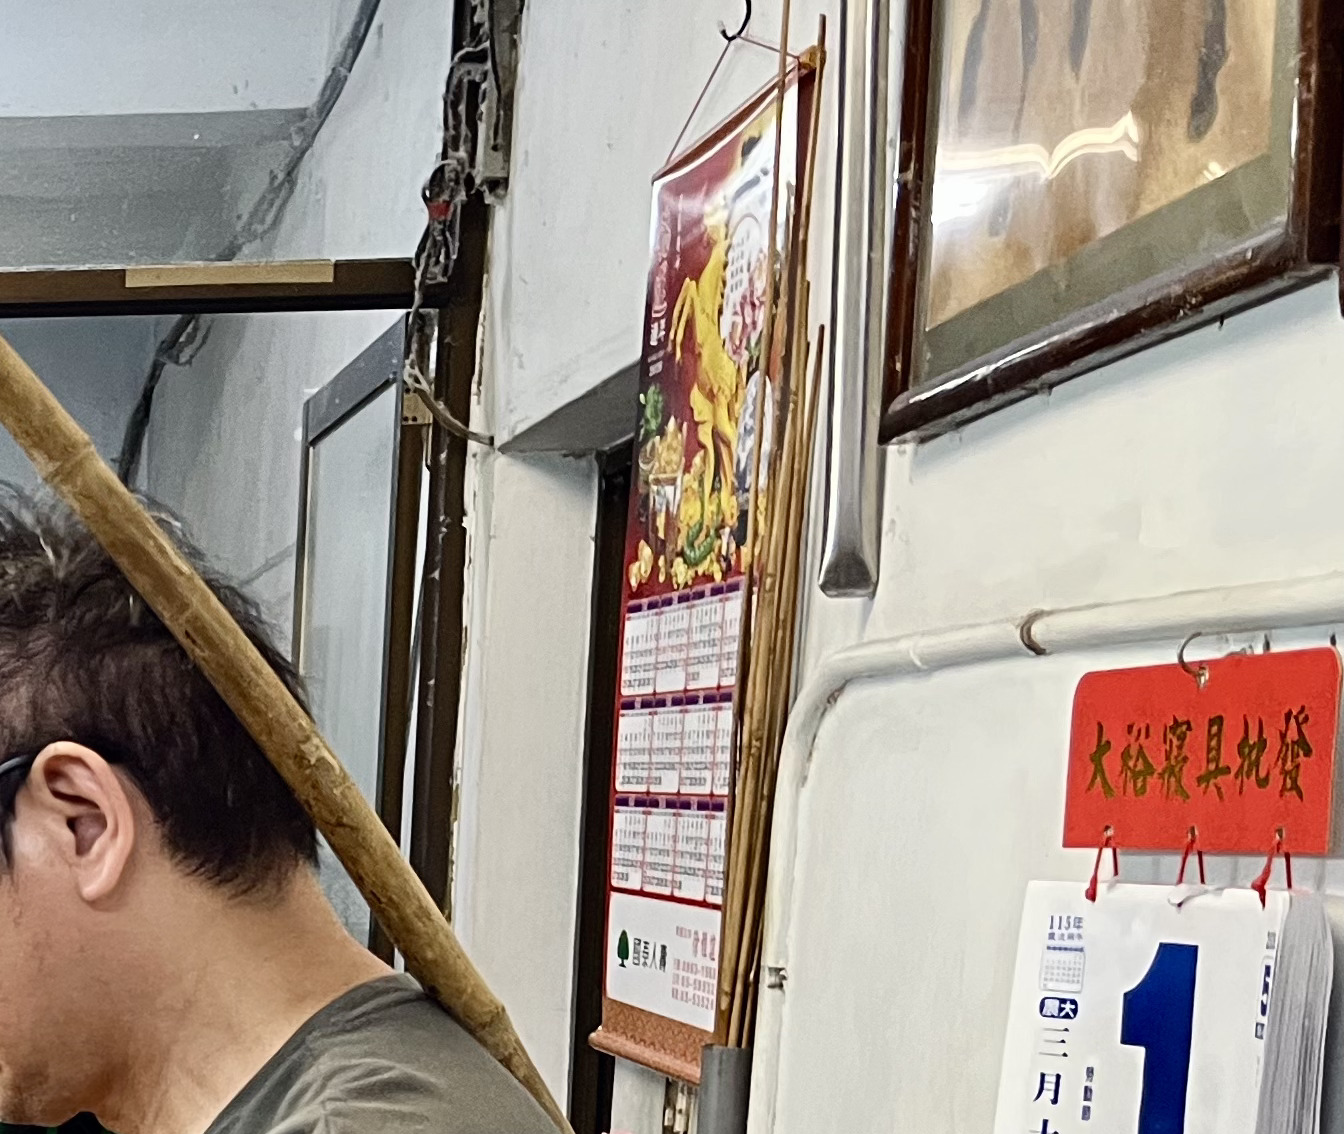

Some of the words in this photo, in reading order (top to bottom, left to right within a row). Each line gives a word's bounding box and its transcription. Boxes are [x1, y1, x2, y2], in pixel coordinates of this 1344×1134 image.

[1085, 705, 1313, 802] 大裕寢具批發
